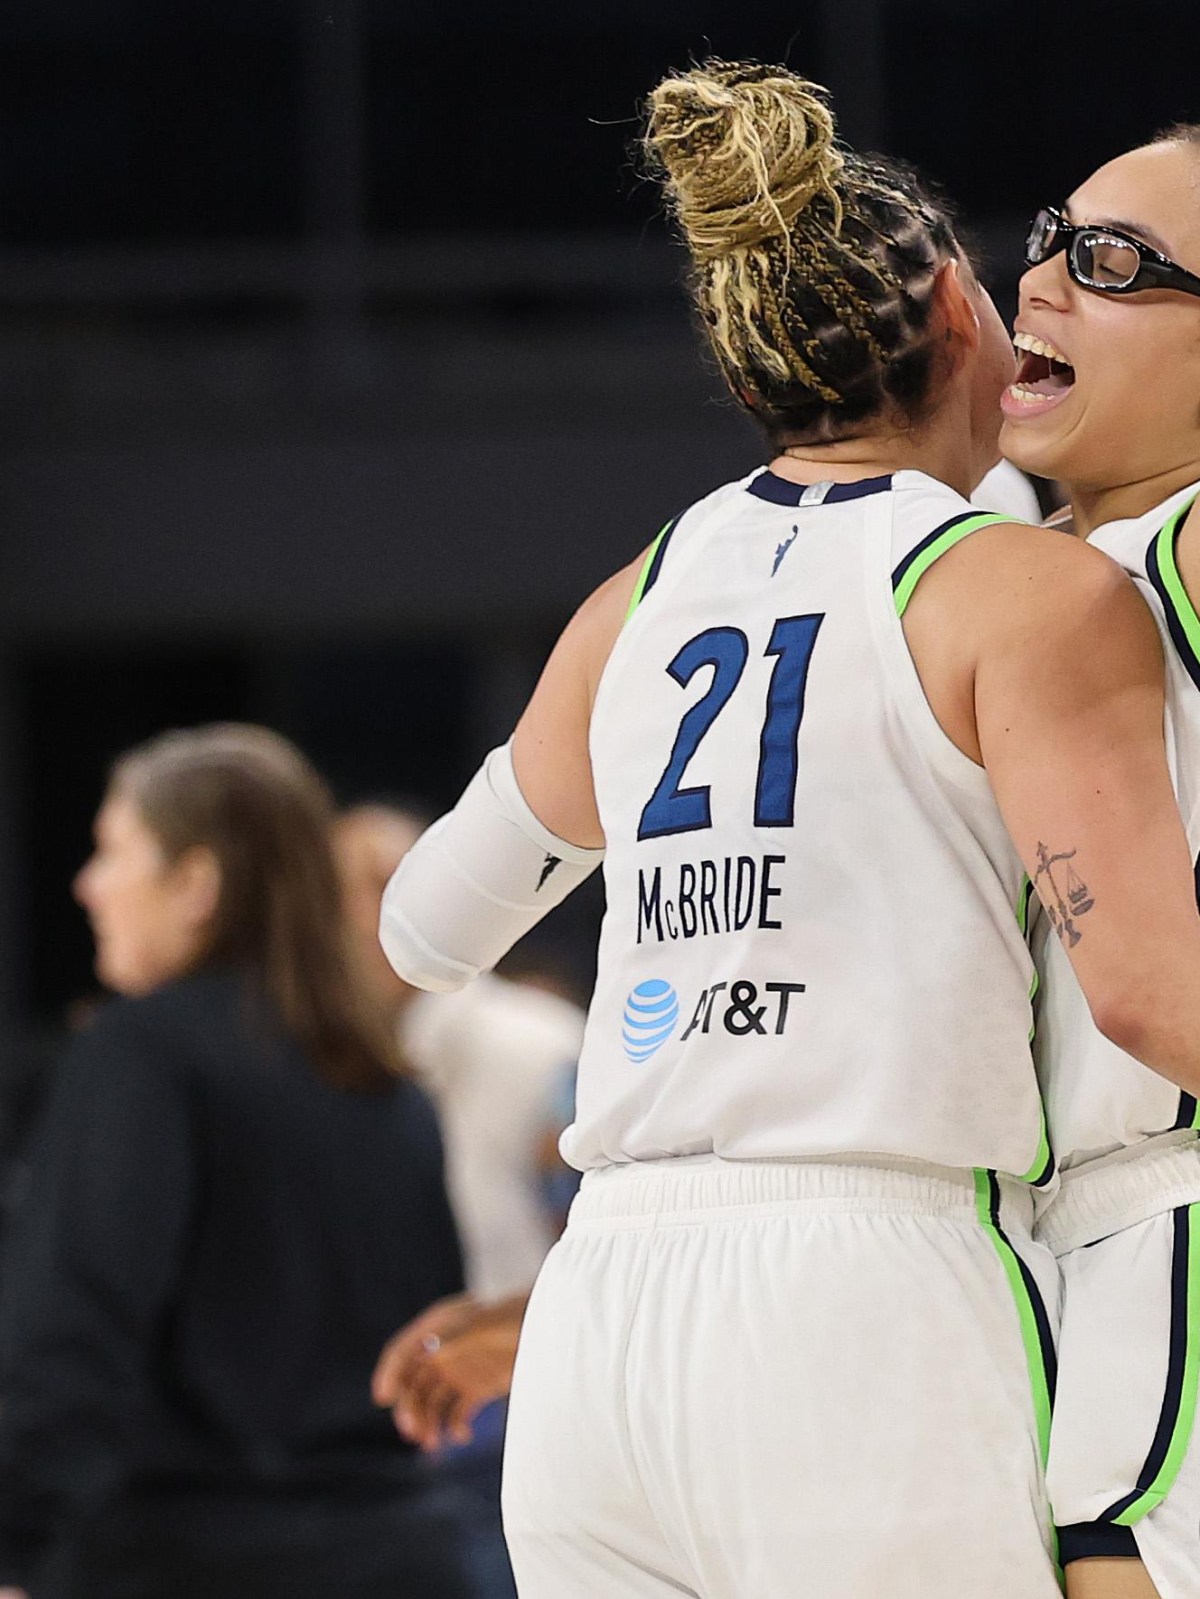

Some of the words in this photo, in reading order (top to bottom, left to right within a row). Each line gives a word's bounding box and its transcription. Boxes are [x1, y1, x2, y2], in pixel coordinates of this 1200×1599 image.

[636, 612, 826, 842] 21
[636, 854, 786, 944] McBRIDE
[680, 979, 806, 1041] AT&T
